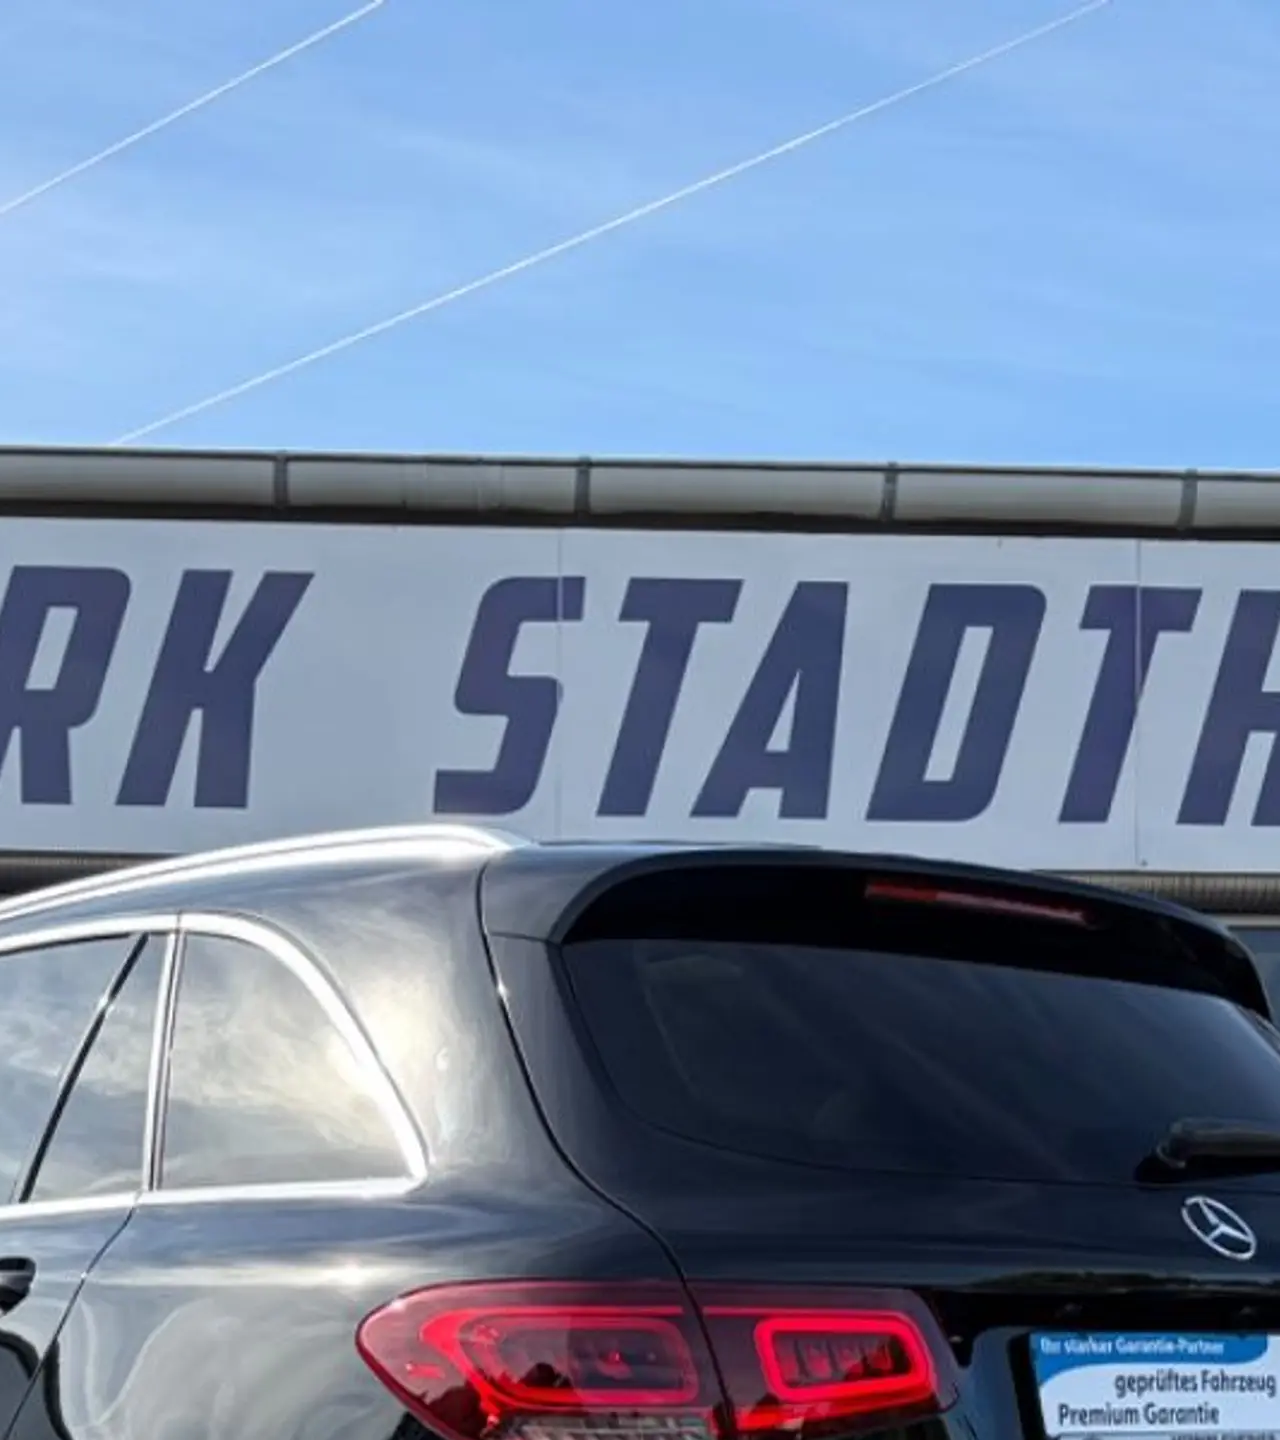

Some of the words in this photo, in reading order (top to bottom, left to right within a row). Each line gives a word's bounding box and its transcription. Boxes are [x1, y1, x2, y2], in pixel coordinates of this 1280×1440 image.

[1115, 1337, 1224, 1354] Garantie-Partner
[1114, 1369, 1198, 1399] geprüftes
[1201, 1370, 1277, 1398] Fahrzeug
[1058, 1402, 1140, 1426] Premium
[1144, 1402, 1220, 1426] Garantie
